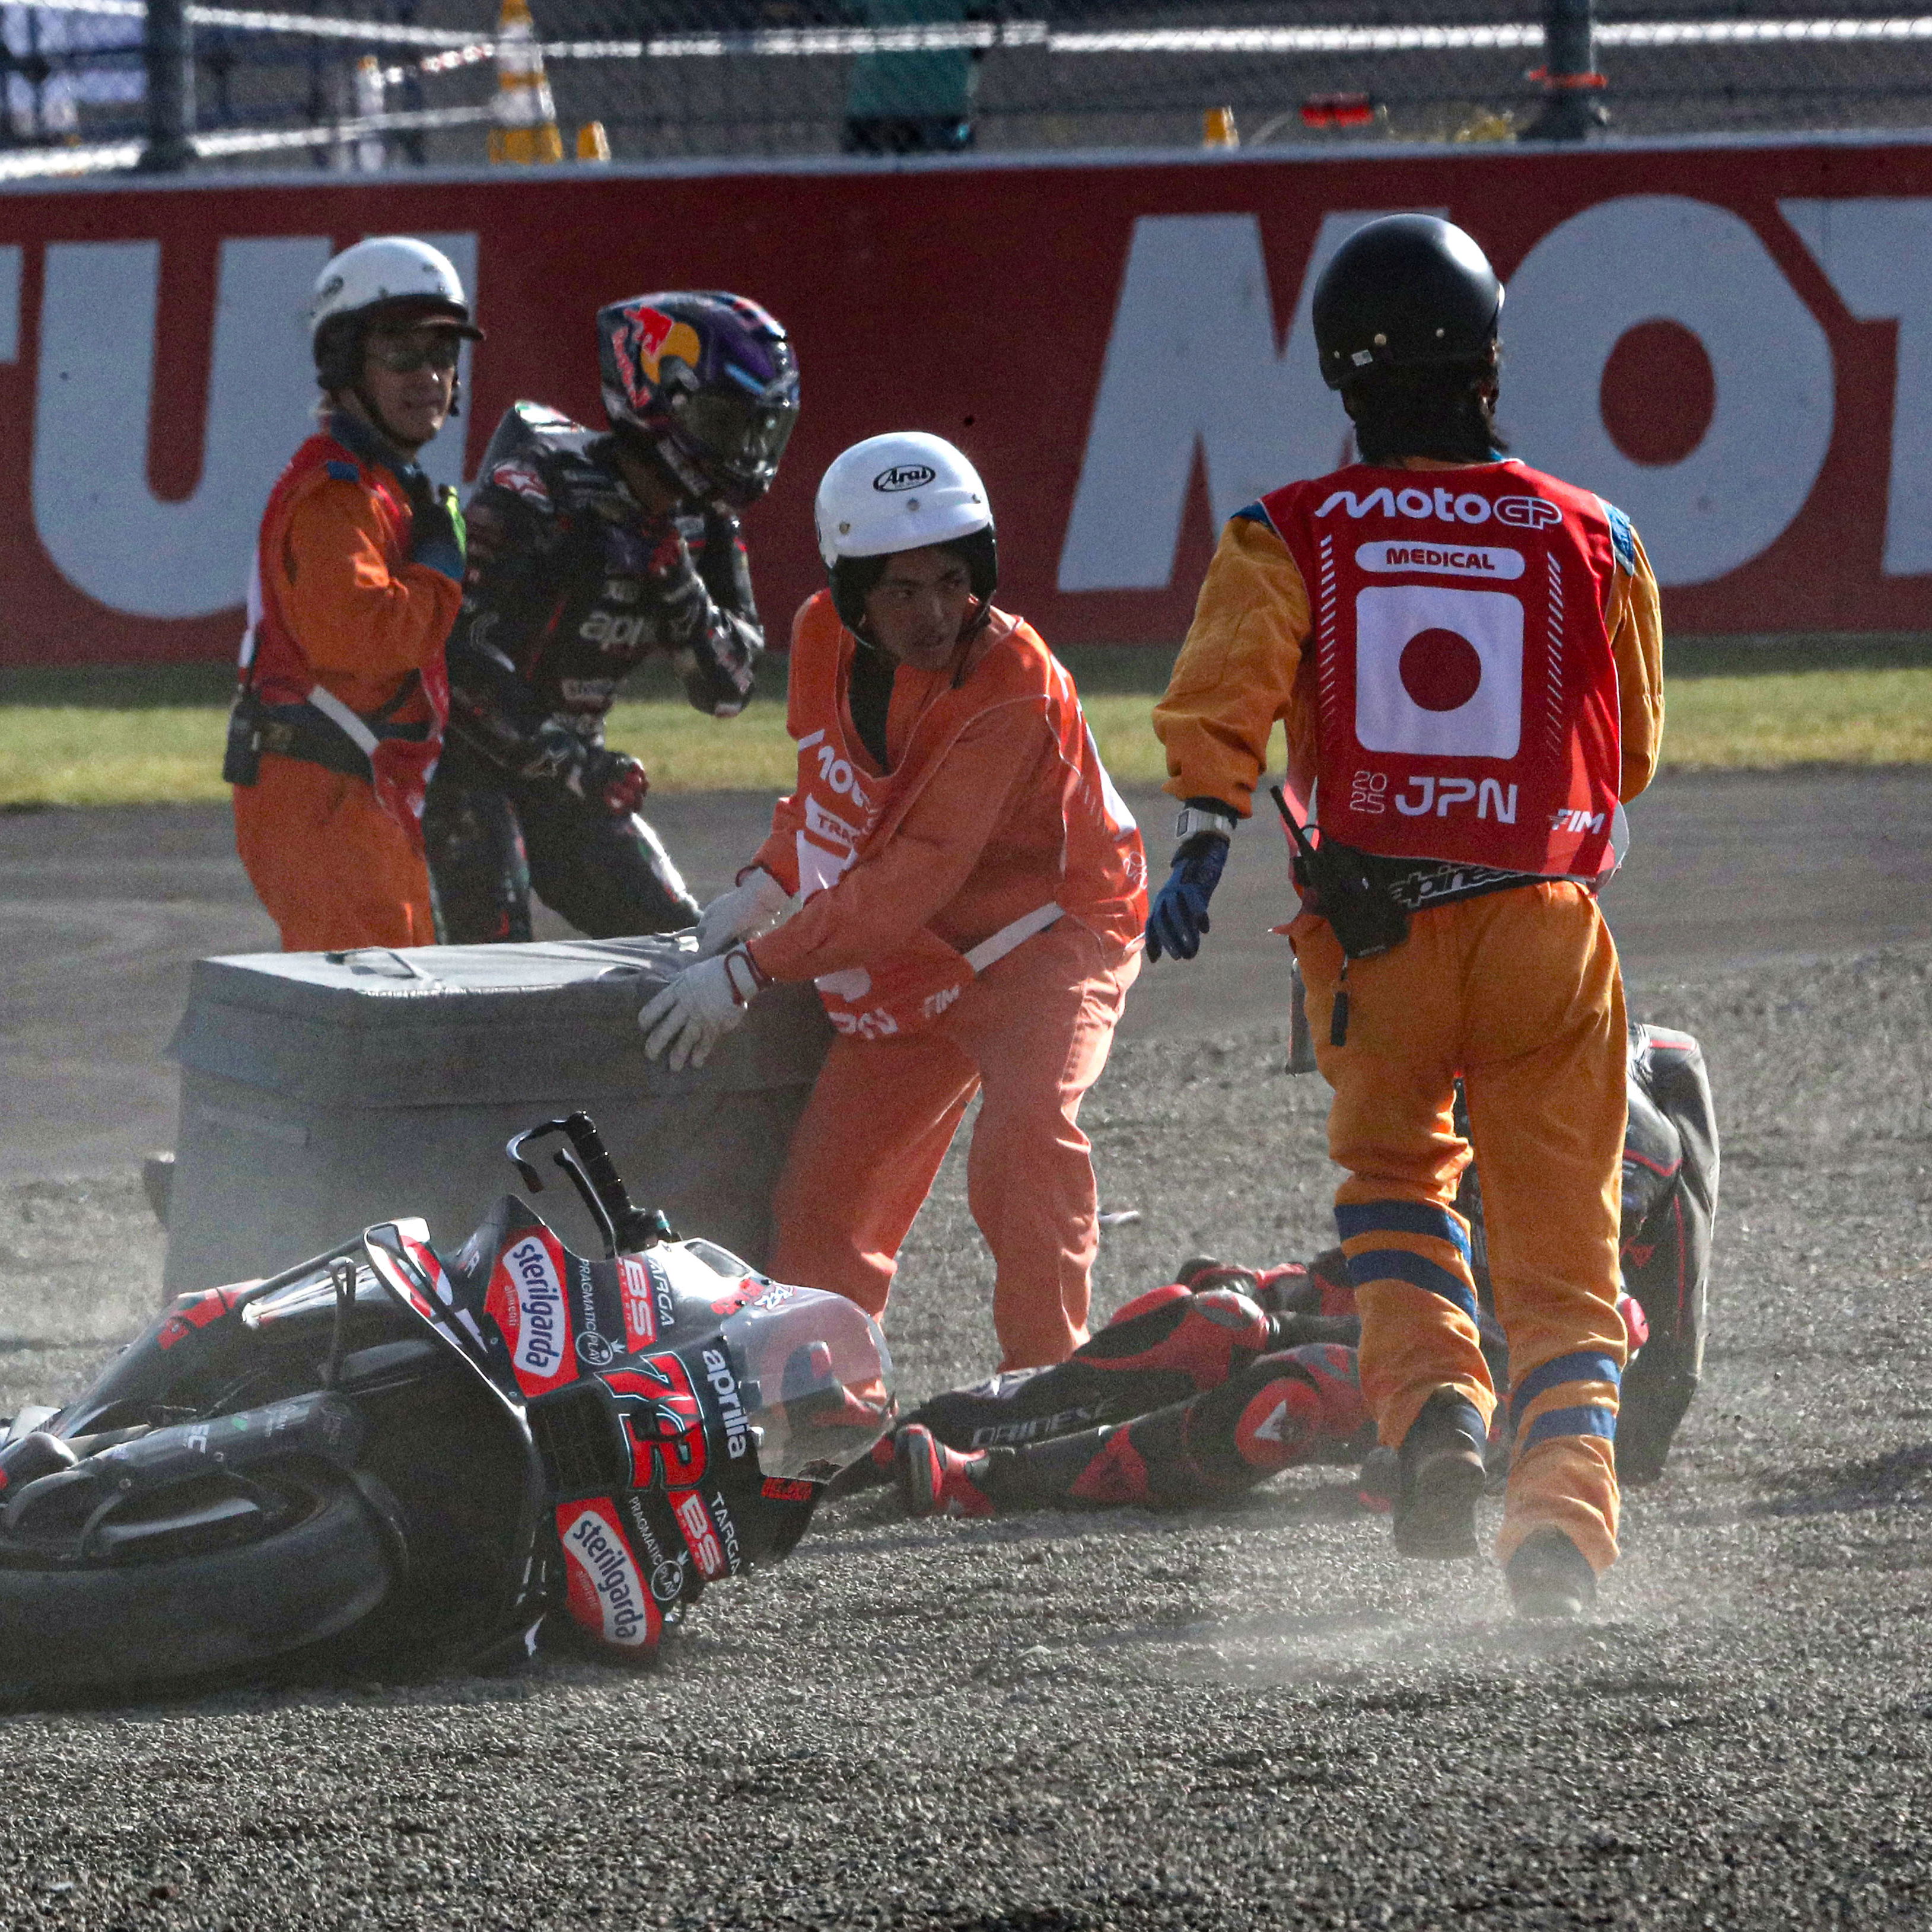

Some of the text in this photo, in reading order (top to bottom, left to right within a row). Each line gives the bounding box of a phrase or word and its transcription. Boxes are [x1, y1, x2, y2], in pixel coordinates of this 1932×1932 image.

[1386, 548, 1495, 570] MEDICAL
[1395, 776, 1518, 824] JPN
[1548, 808, 1605, 834] FIM
[513, 1244, 560, 1368] sterilgarda
[580, 1257, 597, 1332] PRAGMATIC
[624, 1258, 653, 1336] BS
[648, 1258, 675, 1327] ARGA
[587, 1335, 602, 1363] PLAY
[702, 1349, 751, 1459] aprilia
[629, 1496, 664, 1565] PRAGMATIC
[681, 1494, 721, 1575] BS
[712, 1491, 741, 1575] TARGA
[573, 1520, 643, 1638] sterilgarda
